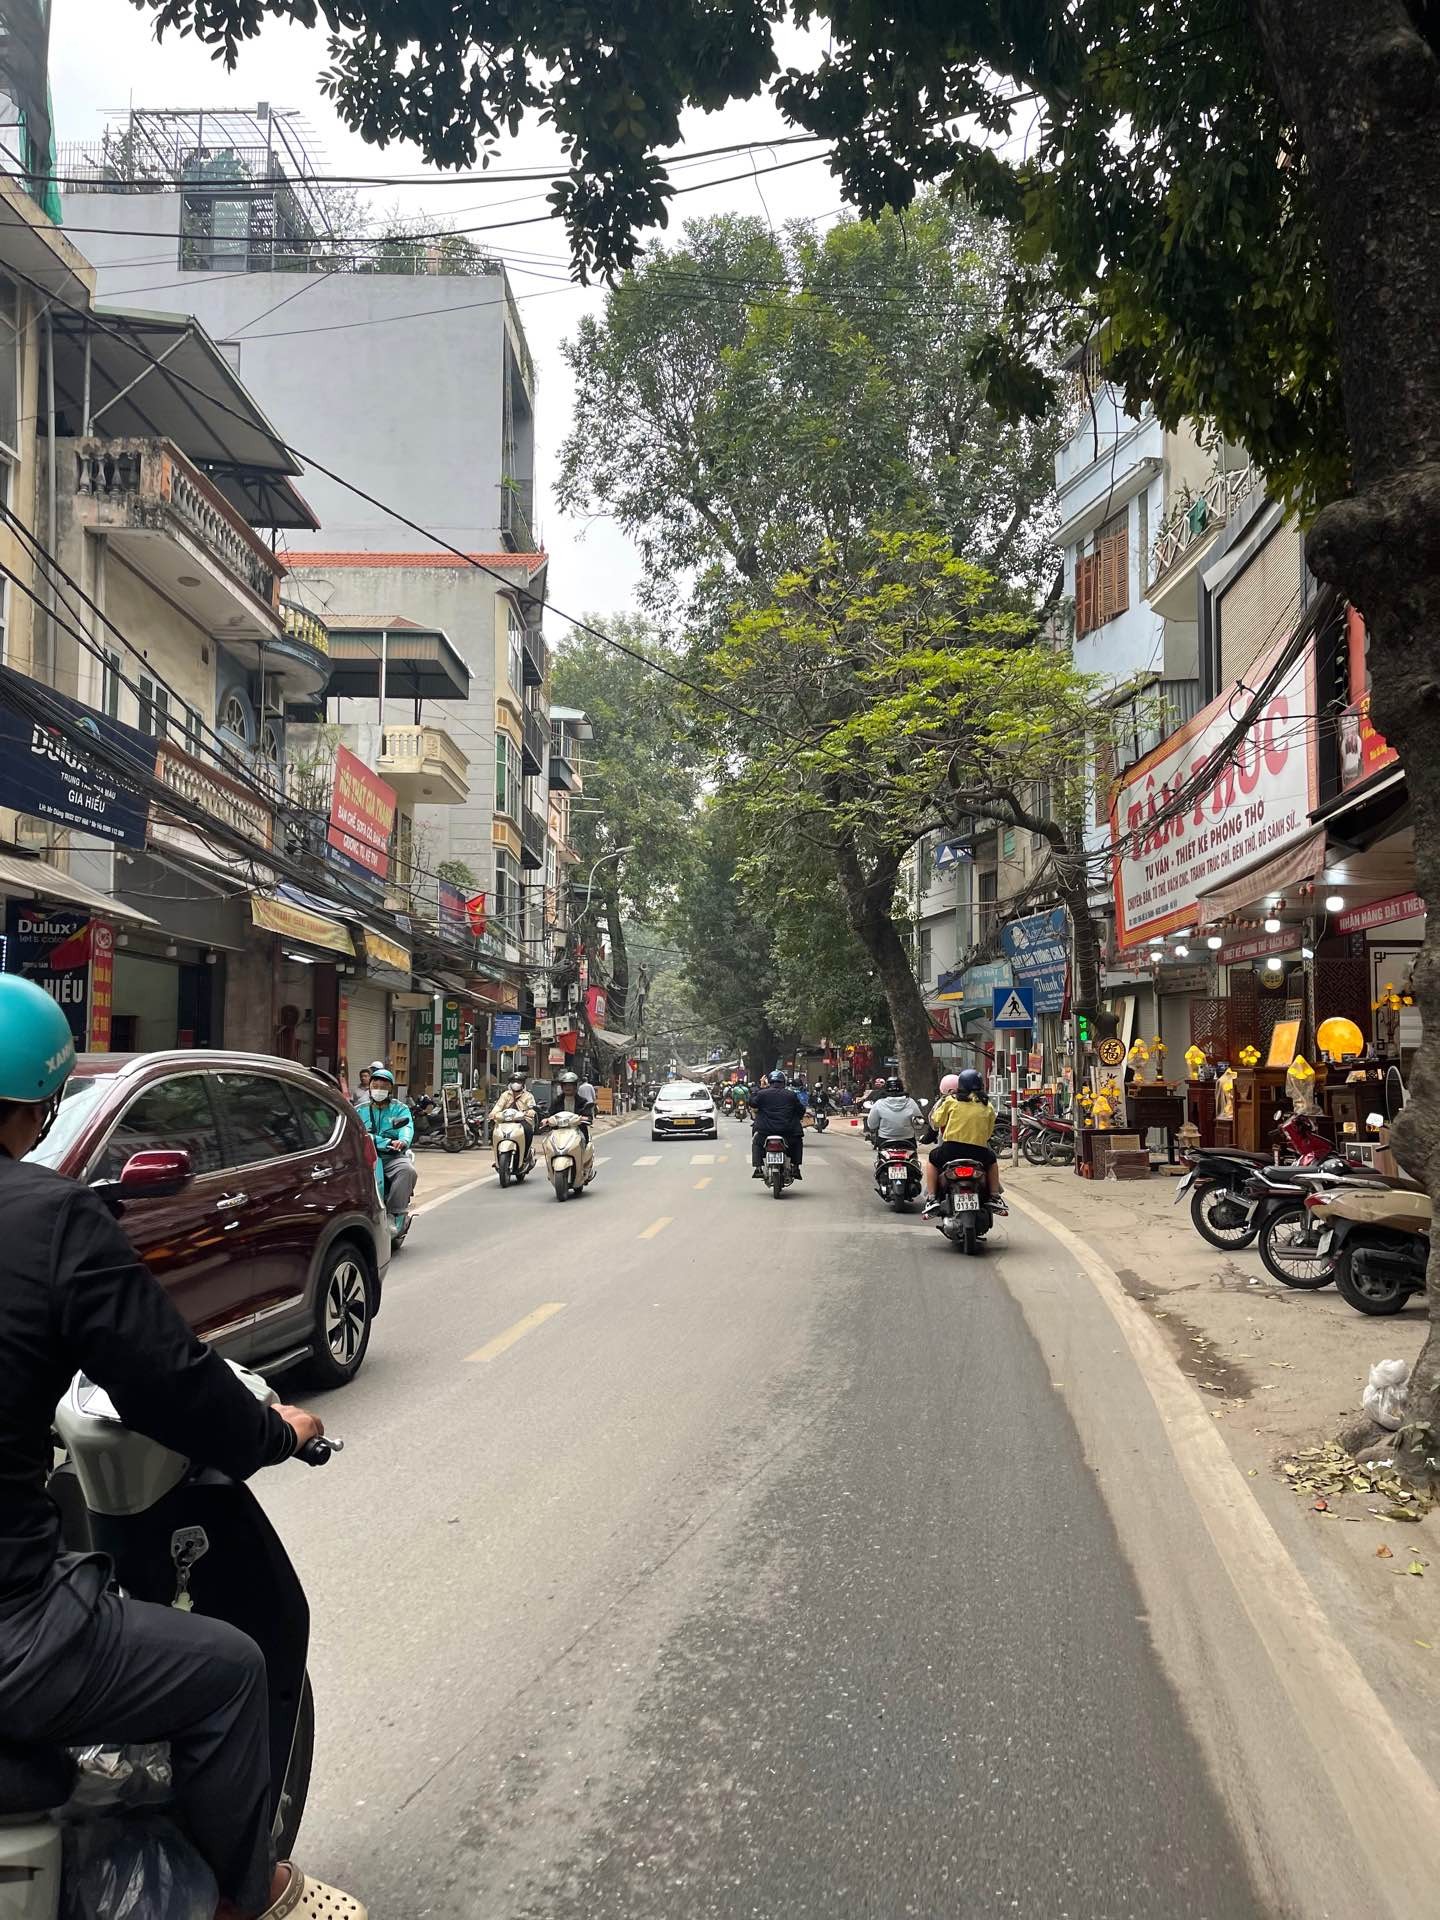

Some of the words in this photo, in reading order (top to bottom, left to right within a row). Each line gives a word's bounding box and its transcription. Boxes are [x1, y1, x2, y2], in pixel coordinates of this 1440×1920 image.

[60, 771, 80, 787] TRUNG
[68, 789, 83, 806] GIA
[18, 919, 71, 934] Dulux
[1340, 913, 1360, 931] NHẬN
[1361, 908, 1383, 925] HÀNG
[43, 972, 83, 1003] HIẾU
[446, 1013, 458, 1031] TỦ
[443, 1035, 459, 1050] BẾP
